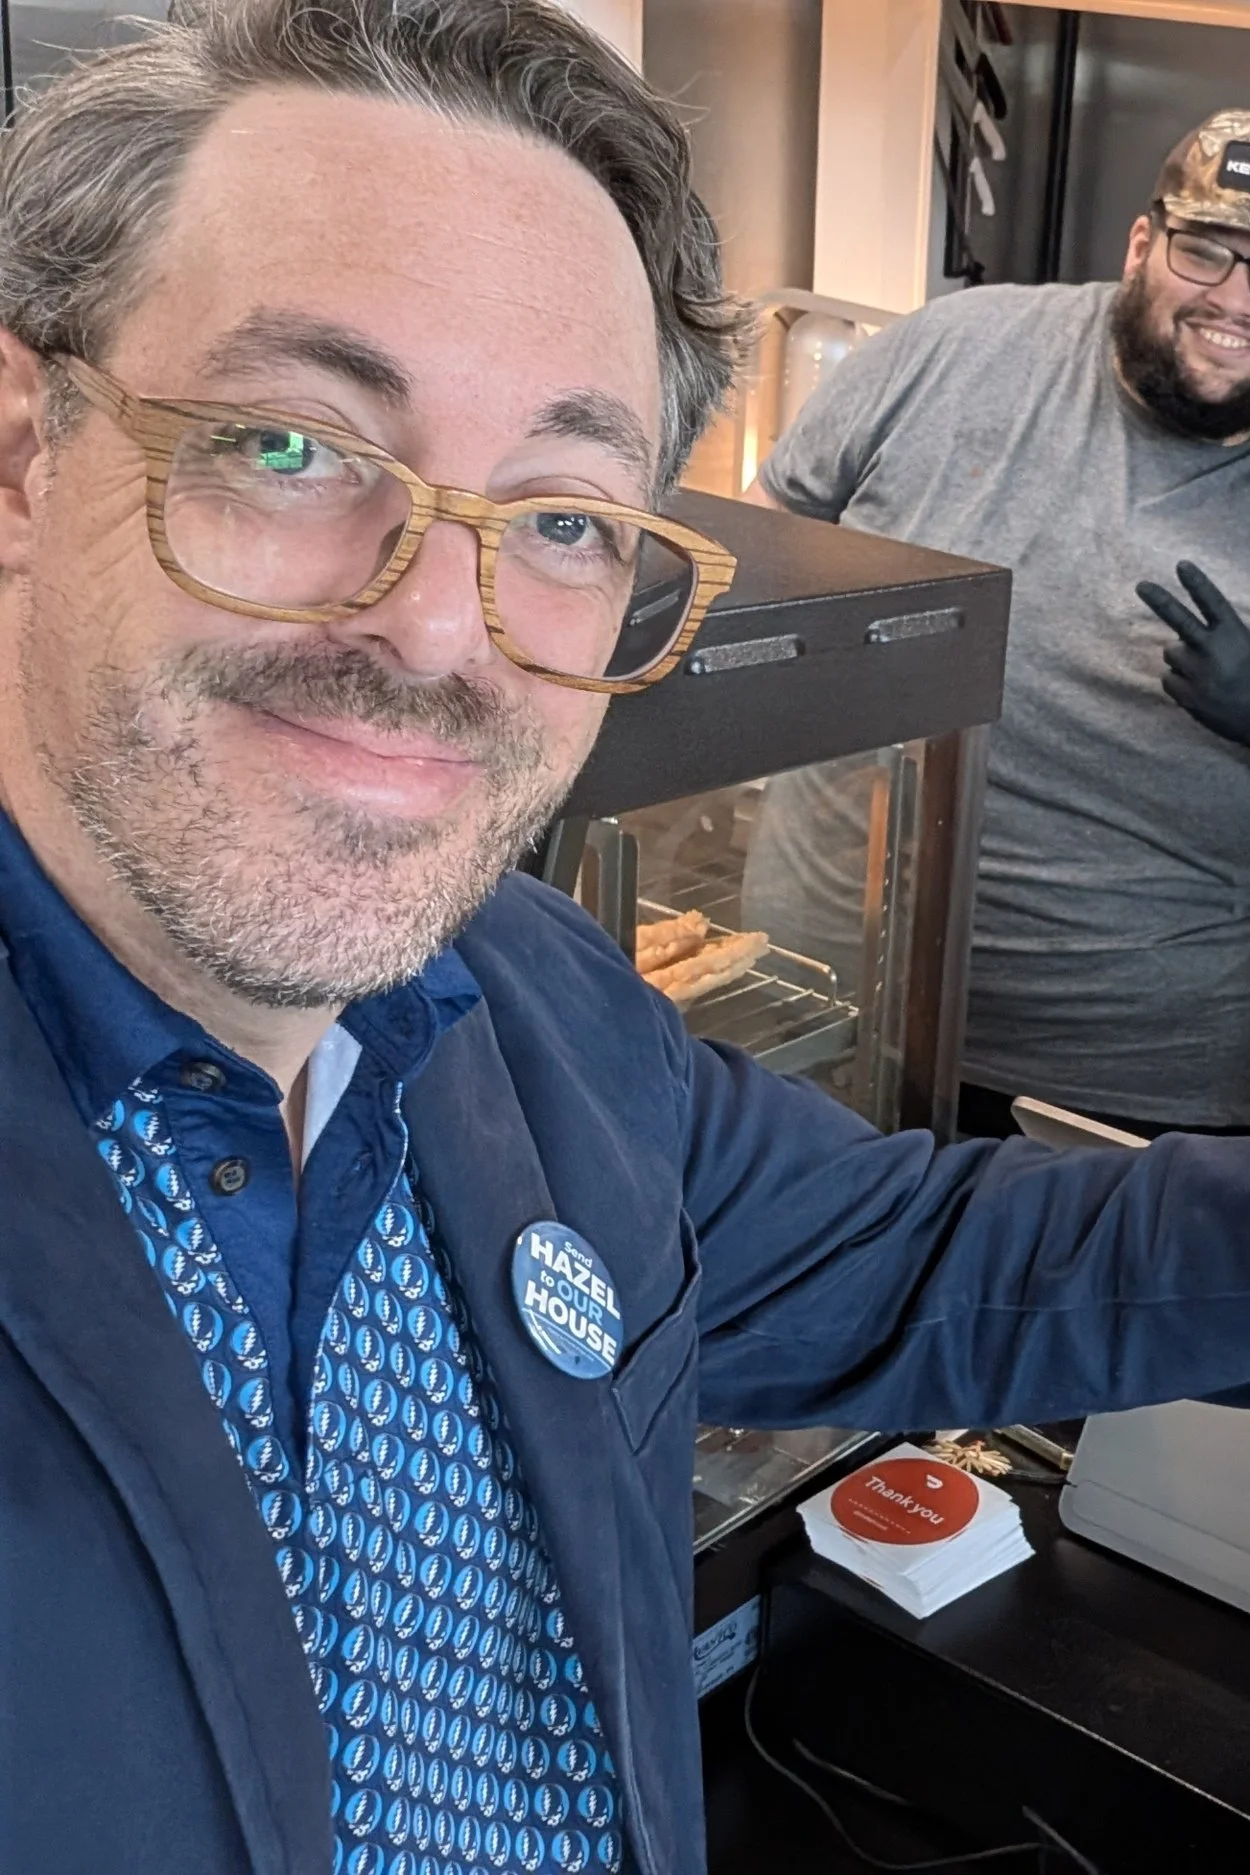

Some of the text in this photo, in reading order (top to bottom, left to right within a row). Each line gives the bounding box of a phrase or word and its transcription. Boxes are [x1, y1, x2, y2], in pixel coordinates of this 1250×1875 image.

[530, 1232, 621, 1320] HAZEL
[564, 1240, 593, 1269] Send
[524, 1279, 617, 1366] HOUSE
[540, 1269, 604, 1326] to OUR
[865, 1475, 914, 1508] Thank
[907, 1503, 945, 1525] you
